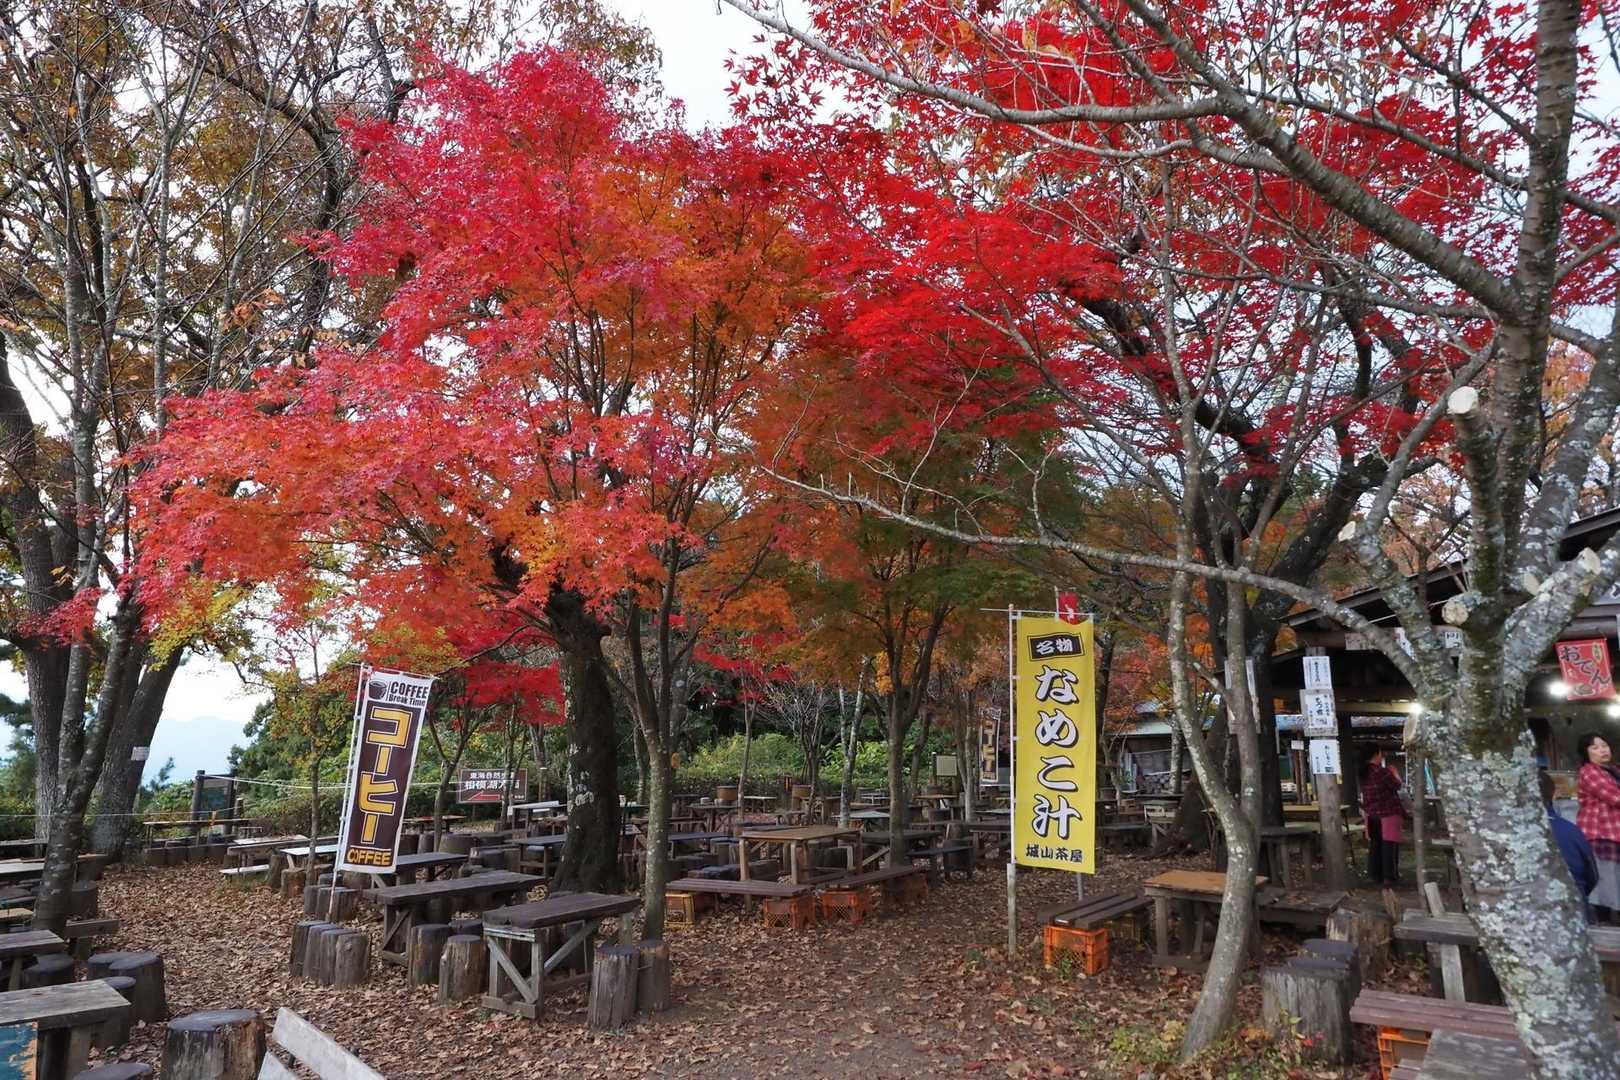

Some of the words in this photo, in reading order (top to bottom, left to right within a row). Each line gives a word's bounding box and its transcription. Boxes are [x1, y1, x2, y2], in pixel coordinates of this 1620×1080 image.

[1036, 638, 1073, 655] 名物
[1560, 647, 1611, 684] おでん
[390, 681, 429, 699] COFFEE
[388, 693, 408, 704] Break
[409, 697, 426, 707] Time
[1032, 664, 1083, 839] なめこ汁
[360, 706, 413, 844] コーヒー
[347, 848, 392, 865] COFFEE
[1026, 843, 1083, 863] 城山茶屋
